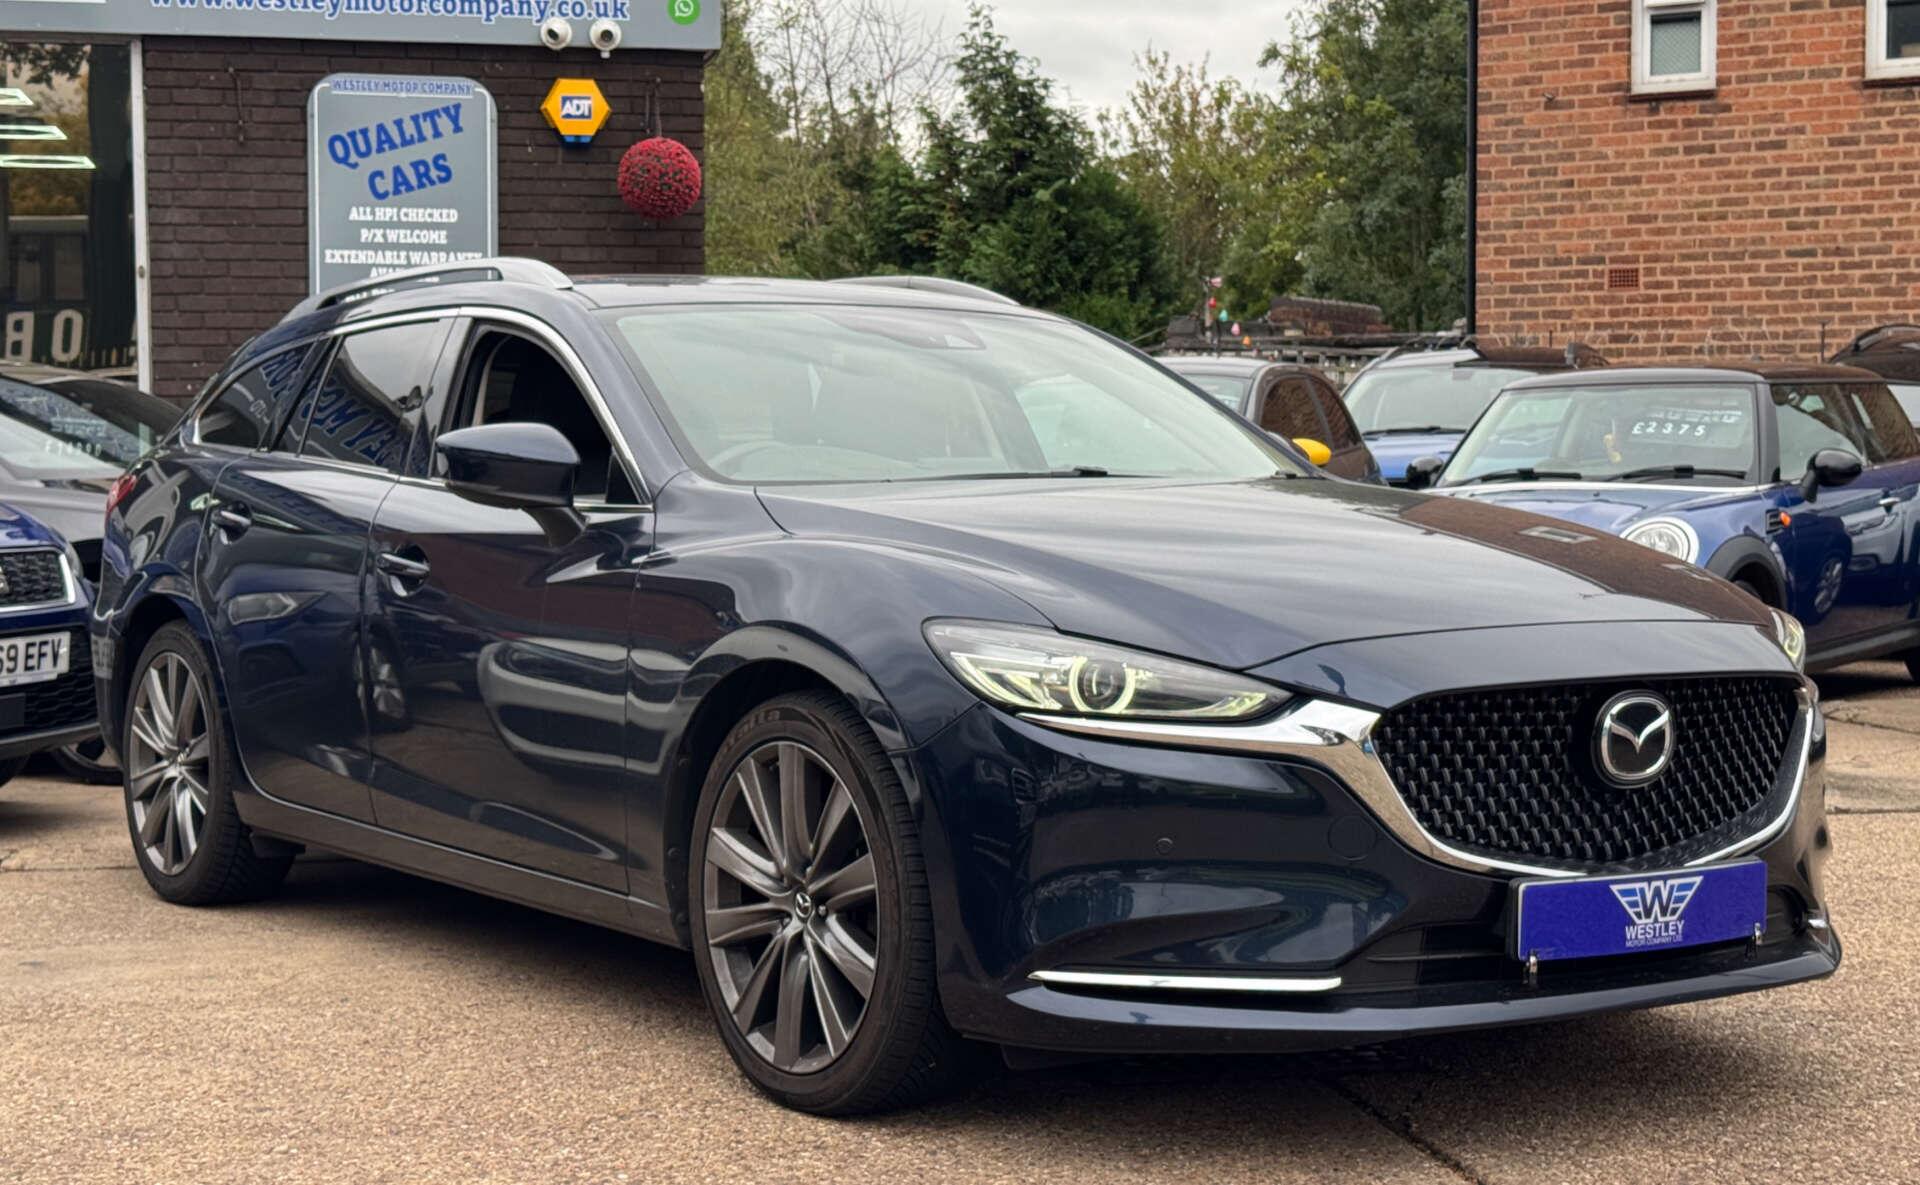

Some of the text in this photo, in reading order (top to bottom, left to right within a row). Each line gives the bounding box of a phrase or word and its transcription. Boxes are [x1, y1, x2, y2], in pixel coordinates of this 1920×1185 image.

[333, 79, 379, 91] WESTLEY
[422, 82, 473, 95] COMPANY
[561, 98, 592, 116] ADT
[328, 103, 464, 169] QUALITY
[368, 153, 453, 200] CARS
[349, 207, 458, 223] ALL HPI CHECKED
[360, 228, 447, 244] P/X WELCOME
[325, 249, 408, 265] EXTENDABLE
[1632, 421, 1706, 436] £2375
[24, 639, 62, 672] EFV
[1625, 920, 1684, 940] WESTLEY
